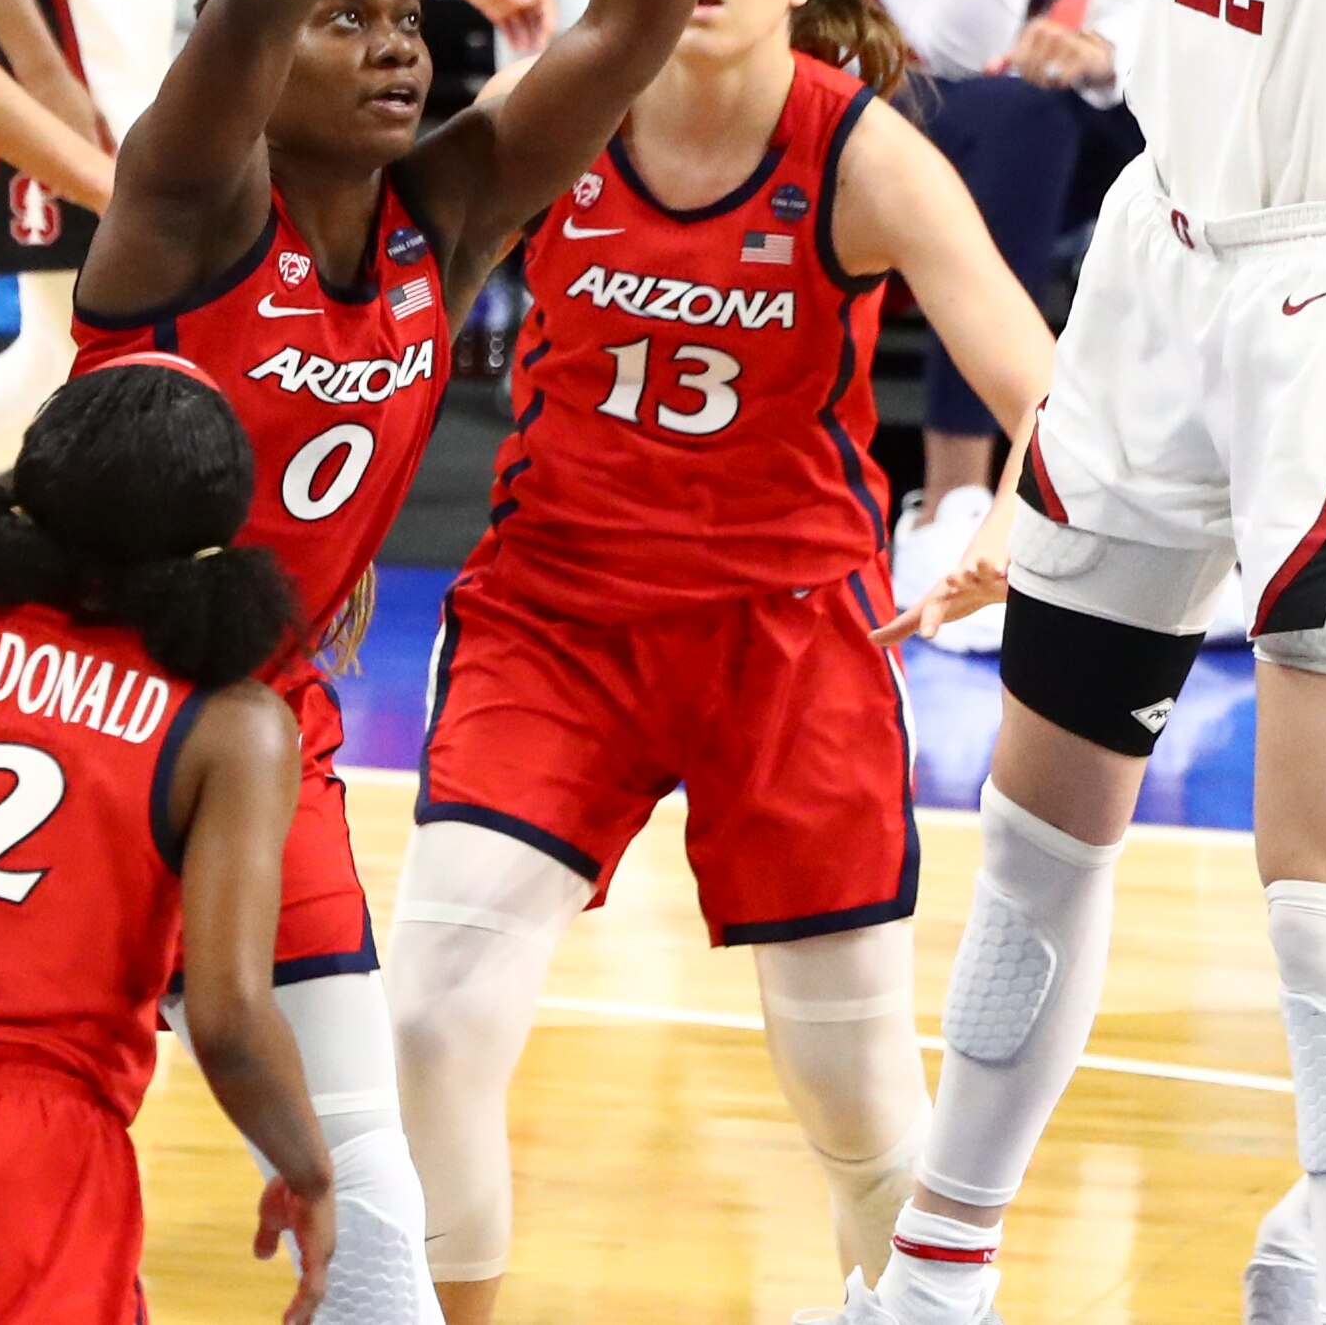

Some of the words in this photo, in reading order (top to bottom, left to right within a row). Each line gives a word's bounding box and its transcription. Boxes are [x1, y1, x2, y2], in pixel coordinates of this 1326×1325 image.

[566, 265, 795, 330] ARIZONA
[596, 337, 742, 436] 13
[281, 422, 375, 521] 0
